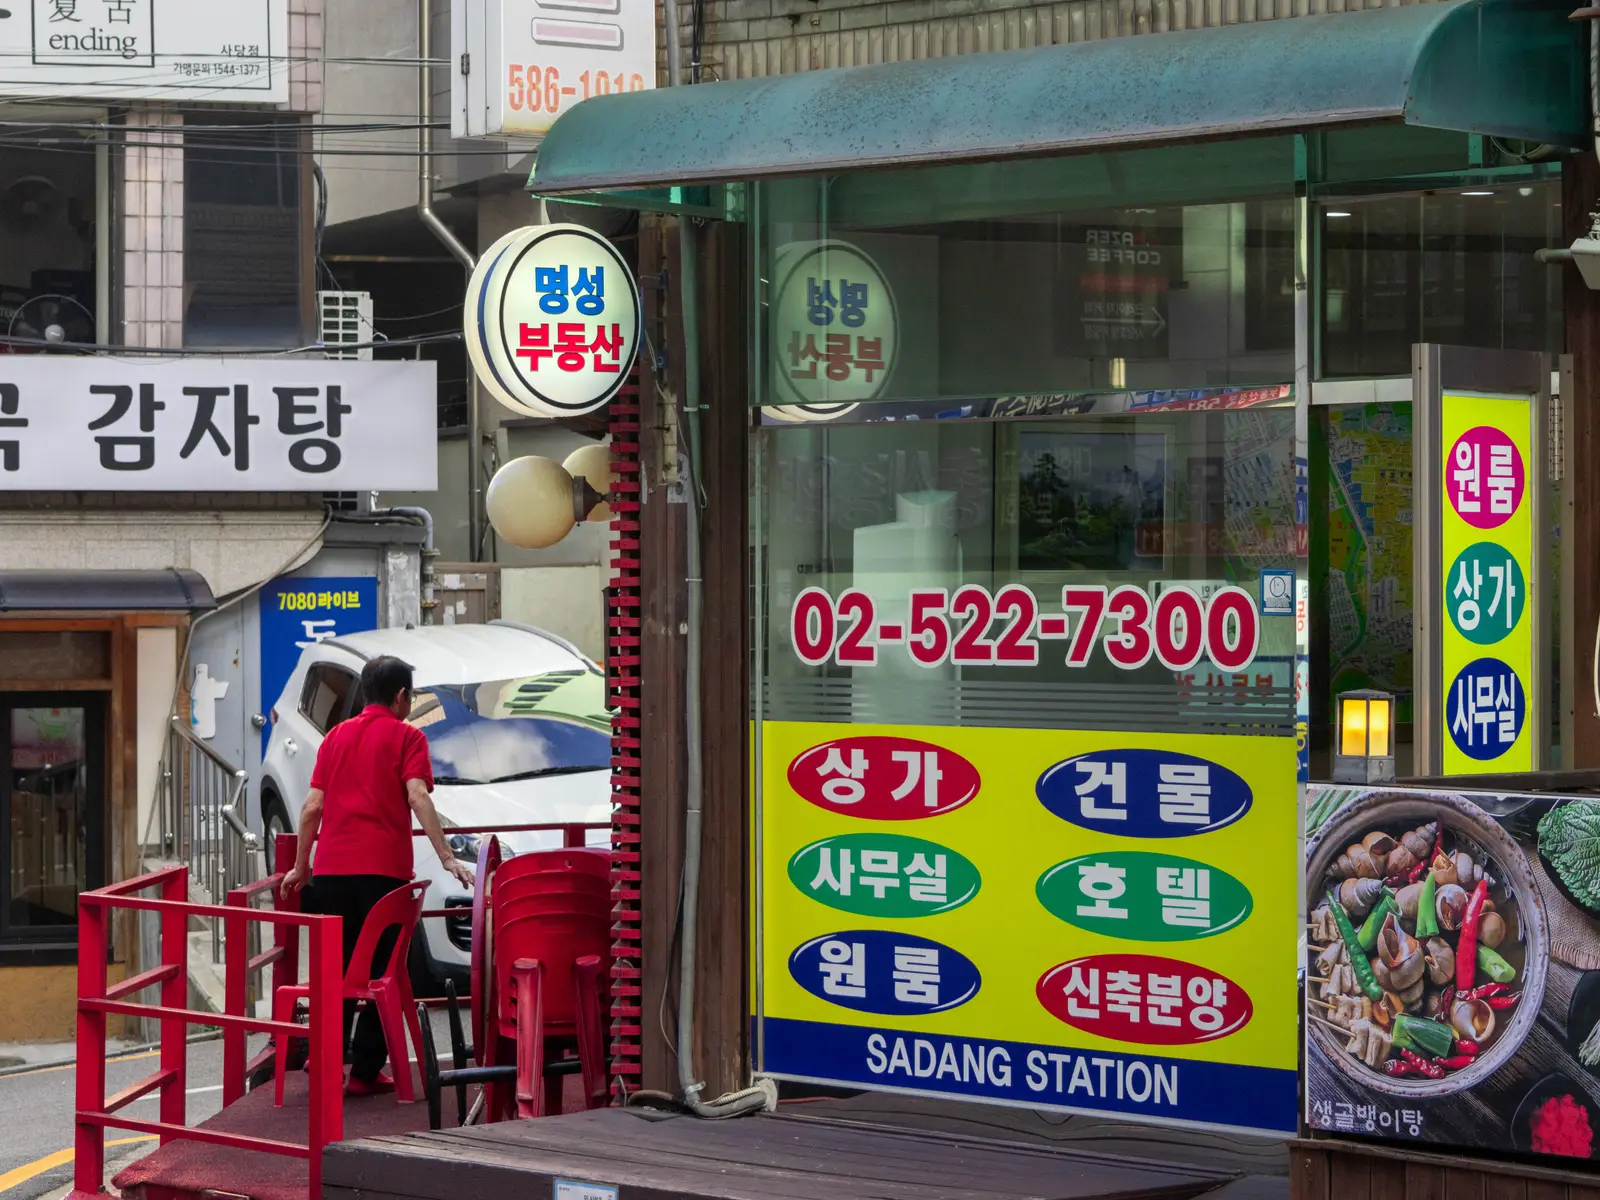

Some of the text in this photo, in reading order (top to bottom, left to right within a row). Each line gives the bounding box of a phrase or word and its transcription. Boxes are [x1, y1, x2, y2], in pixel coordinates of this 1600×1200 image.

[49, 27, 137, 60] ending
[173, 62, 260, 77] 가맹문의 1544-1377
[220, 43, 260, 57] 사당점
[535, 264, 606, 316] 명성
[515, 322, 625, 373] 부동산
[88, 383, 352, 474] 감자탕
[1453, 440, 1517, 514] 원룸
[277, 590, 361, 611] 7080라이브
[1453, 558, 1517, 631] 상가
[791, 583, 1260, 672] 02-522-7300
[1452, 672, 1517, 746] 사무실
[815, 747, 944, 808] 상가
[1074, 760, 1212, 825] 건물
[810, 846, 948, 903] 사무실
[1076, 861, 1211, 928] 호텔
[818, 940, 941, 1006] 원룸
[1062, 965, 1228, 1032] 신축분양
[866, 1033, 1179, 1106] SADANG STATION
[1312, 1100, 1424, 1137] 생골뱅이탕
